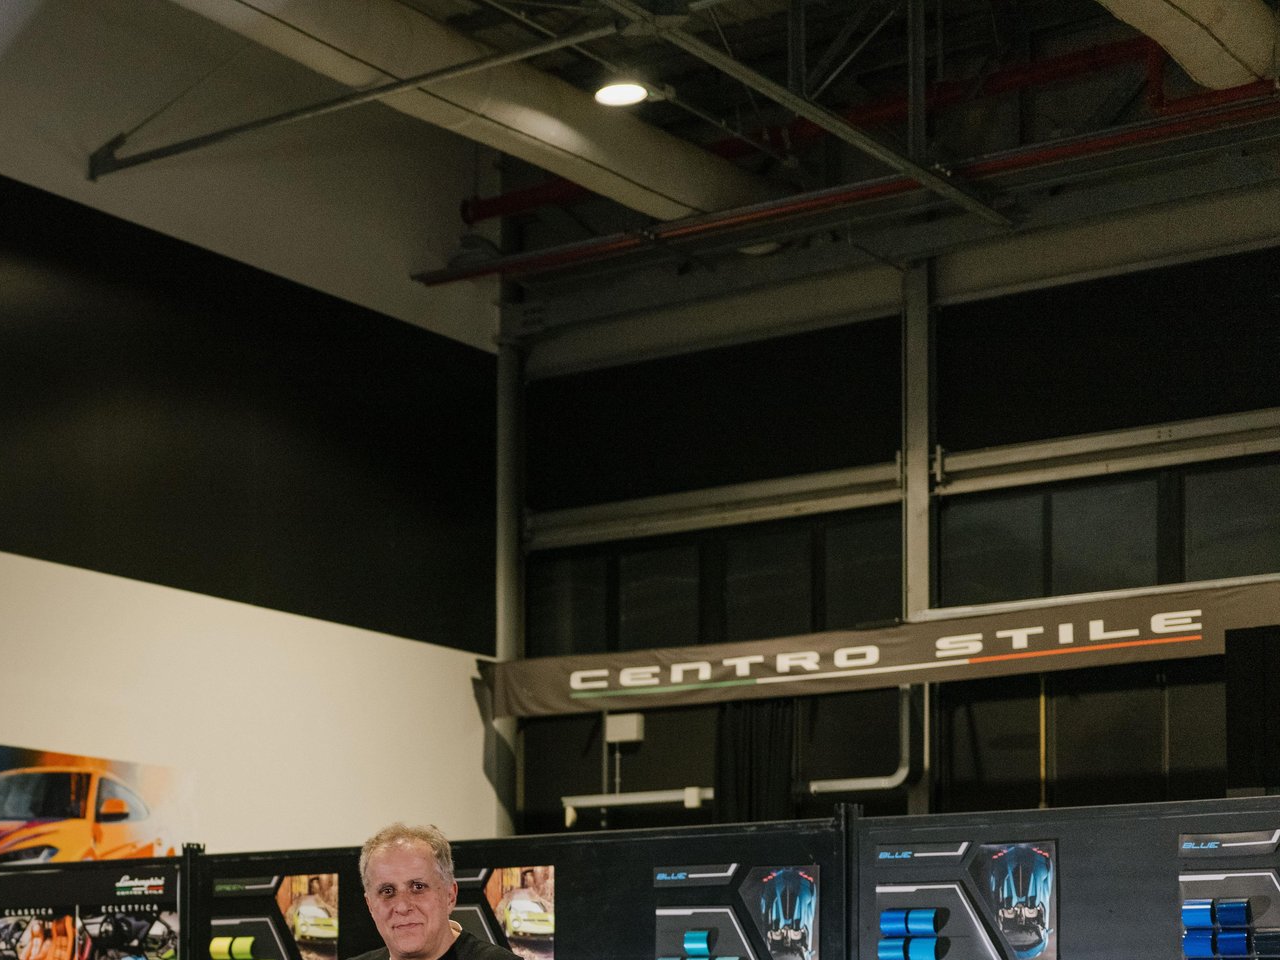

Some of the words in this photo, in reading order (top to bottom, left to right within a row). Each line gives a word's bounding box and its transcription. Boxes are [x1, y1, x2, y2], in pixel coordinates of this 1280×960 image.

[570, 645, 880, 690] CENTRO
[935, 609, 1203, 658] STILE
[1182, 841, 1220, 849] BLUE
[879, 851, 912, 859] BLUE
[4, 908, 54, 916] CLASSICA
[101, 904, 158, 913] ECLETTICA
